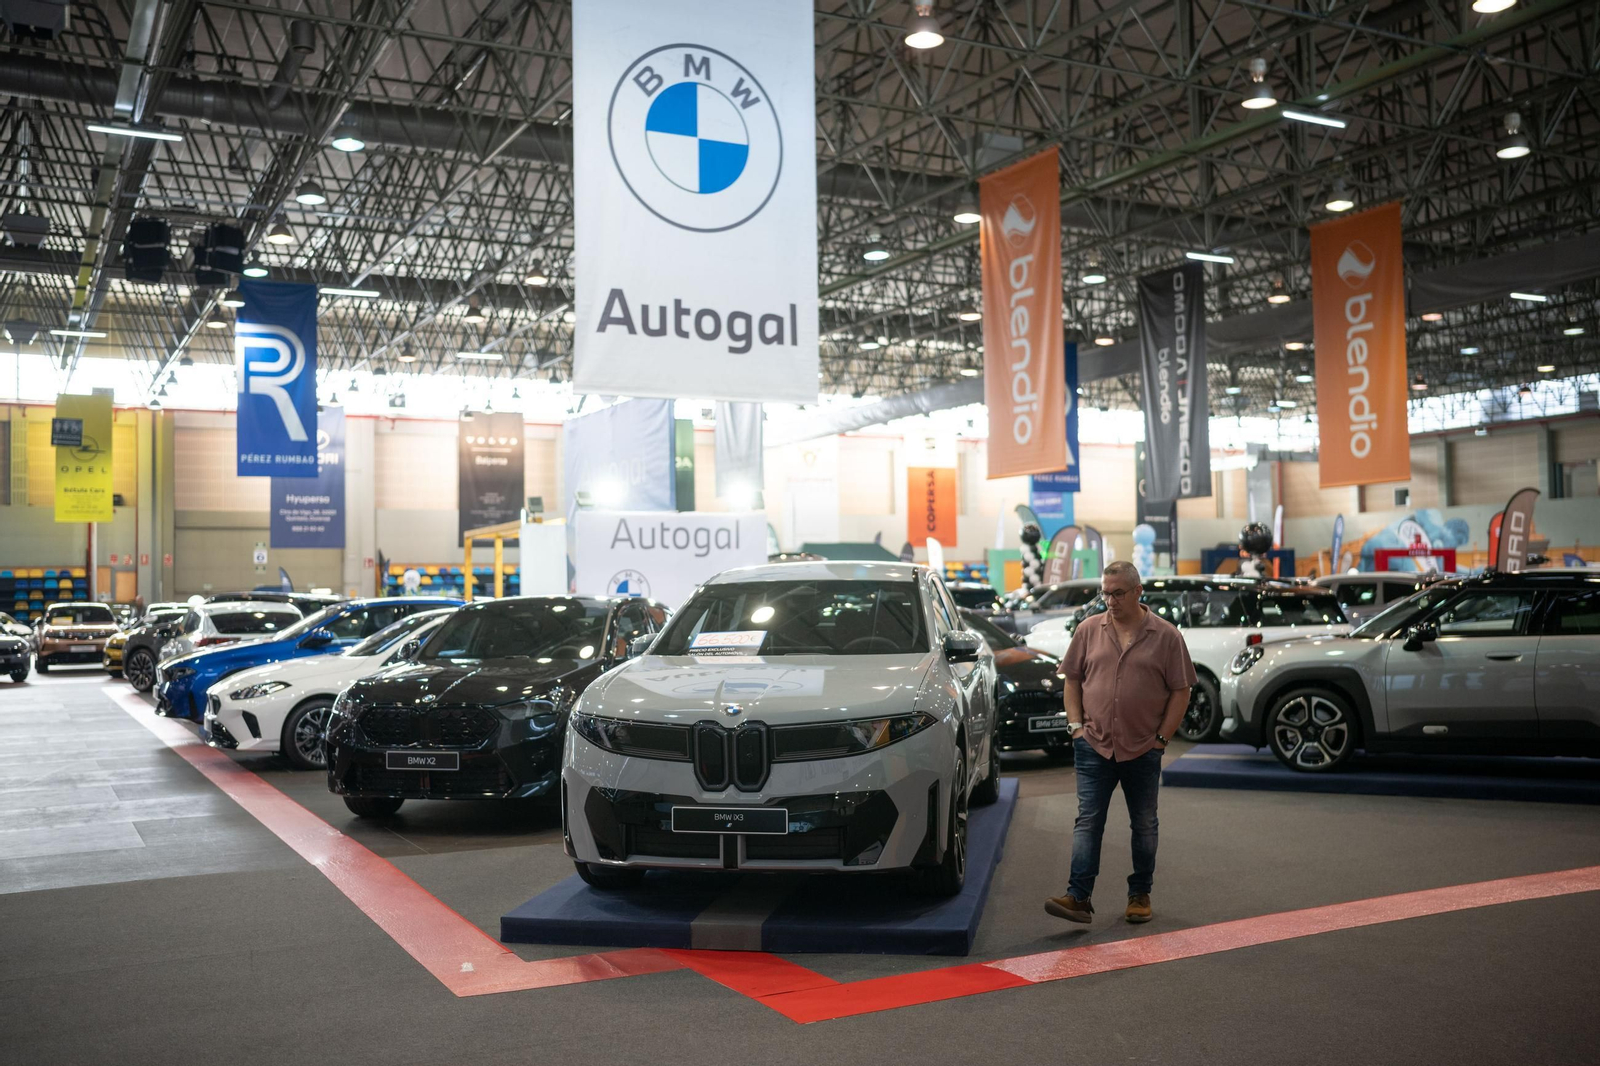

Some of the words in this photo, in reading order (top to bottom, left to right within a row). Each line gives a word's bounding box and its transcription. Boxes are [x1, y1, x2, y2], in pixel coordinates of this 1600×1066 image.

[632, 53, 761, 110] BMW
[596, 288, 798, 354] Autogal
[1009, 254, 1038, 446] blendio
[1158, 347, 1172, 424] blendio
[1345, 293, 1377, 458] blendio
[241, 452, 272, 464] PÉREZ
[275, 454, 315, 465] RUMBAO
[611, 518, 740, 558] Autogal
[1036, 720, 1050, 728] BMW
[407, 756, 425, 764] BMW
[427, 757, 436, 765] X2
[714, 813, 732, 821] BMW
